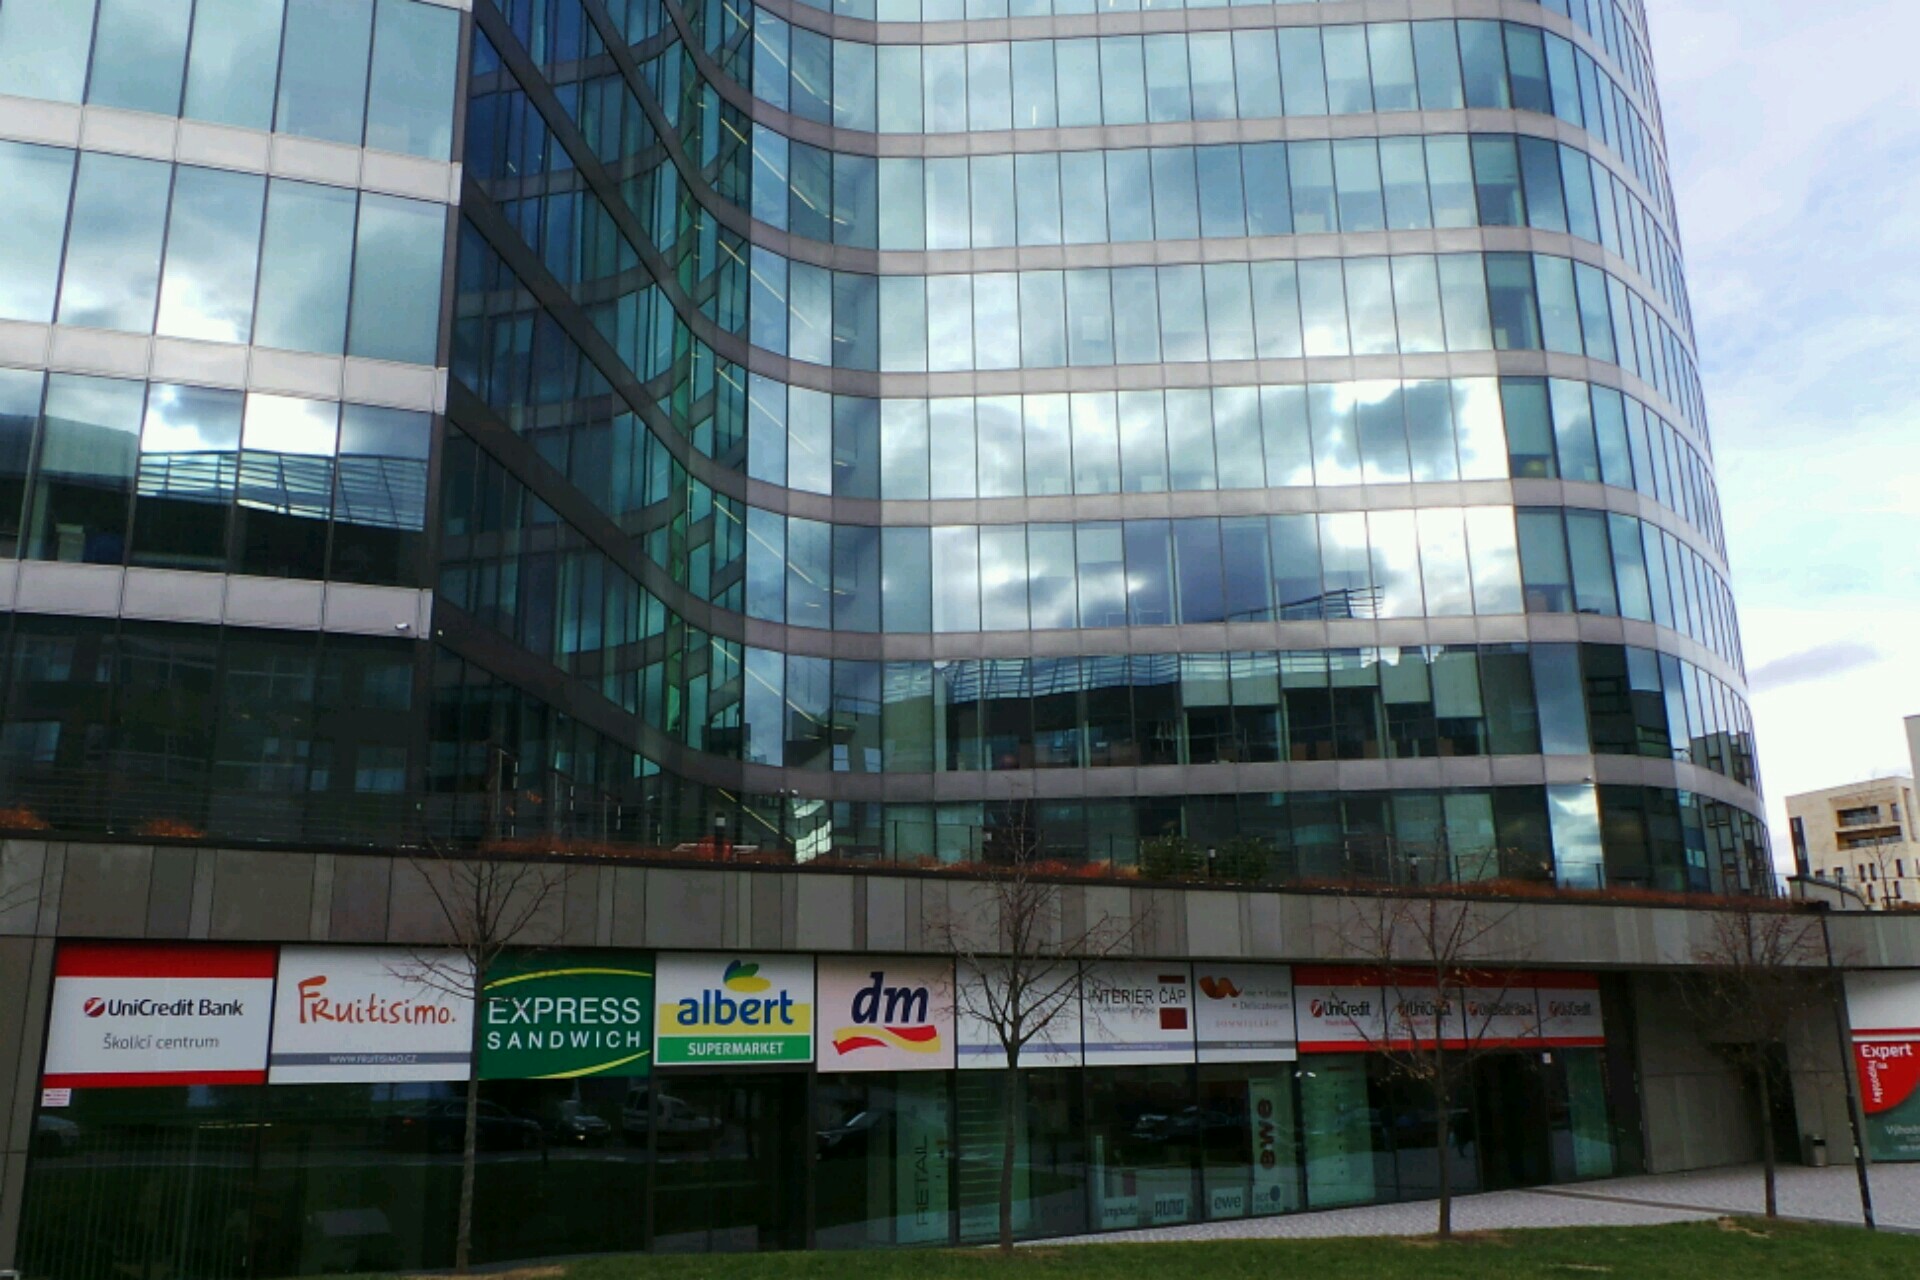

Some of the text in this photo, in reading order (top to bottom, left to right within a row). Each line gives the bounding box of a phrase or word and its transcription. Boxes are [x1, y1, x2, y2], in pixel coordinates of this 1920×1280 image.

[852, 971, 929, 1024] dm
[108, 999, 243, 1016] UniCredit Bank
[488, 997, 641, 1024] EXPRESS
[677, 989, 794, 1025] albert
[156, 1036, 219, 1049] centrum
[487, 1031, 641, 1050] SANDWICH
[687, 1042, 784, 1056] SUPERMARKET
[1861, 1043, 1913, 1060] Expert
